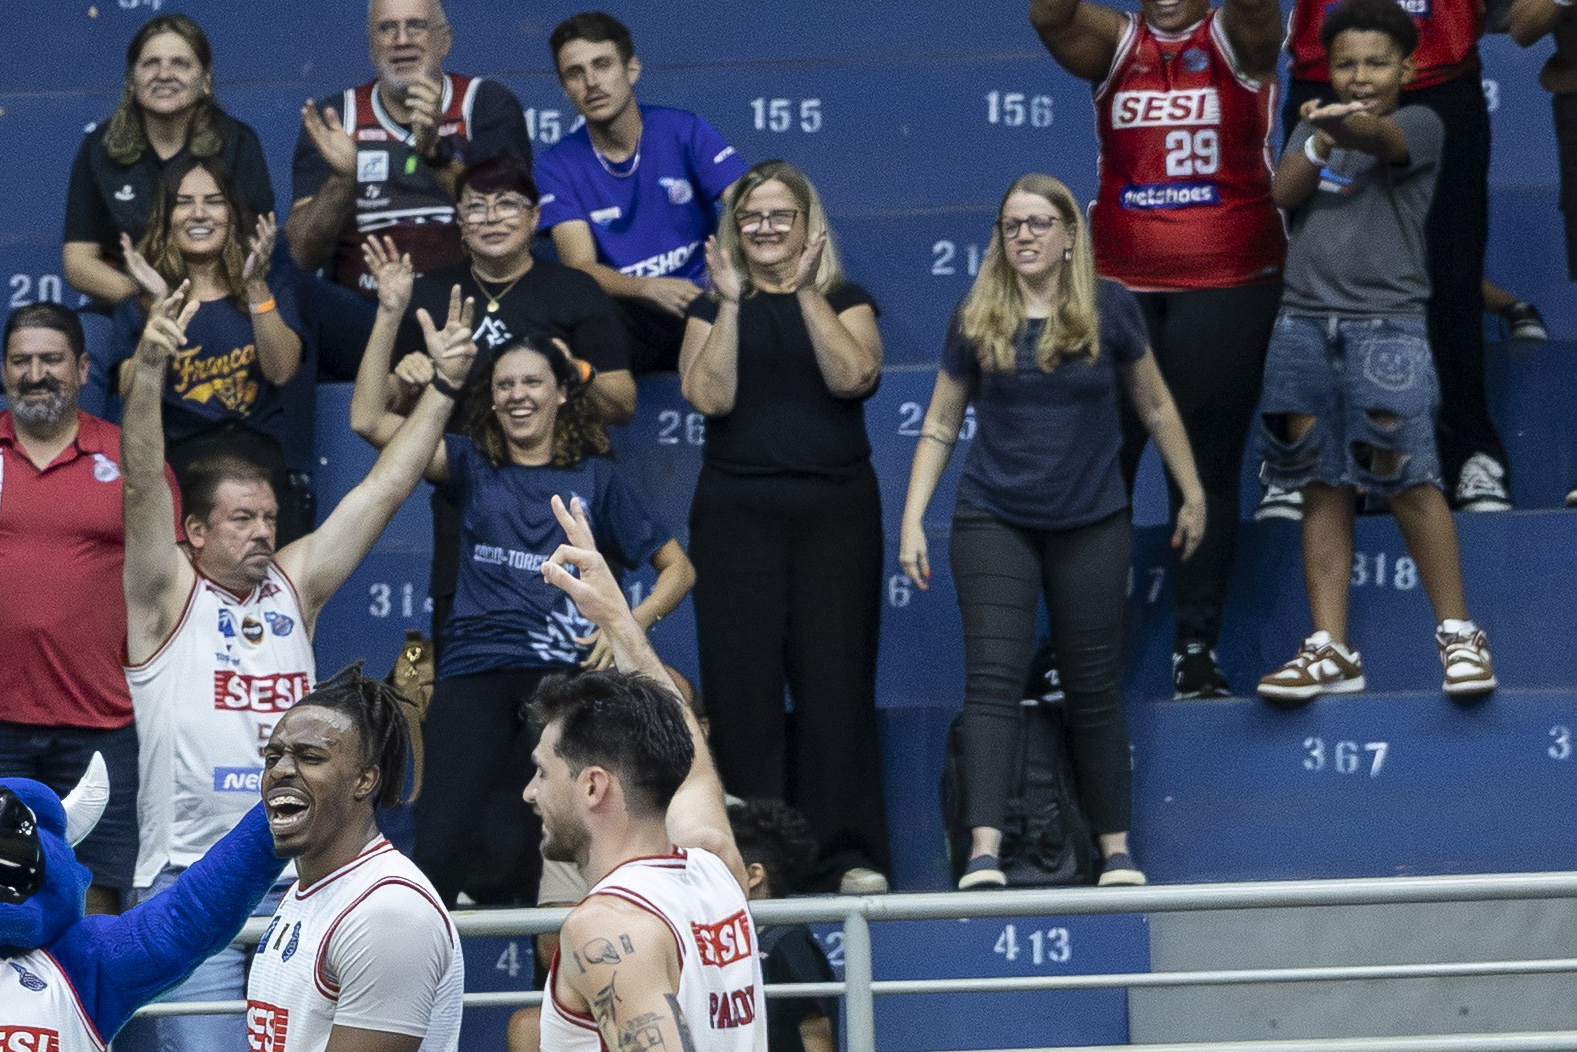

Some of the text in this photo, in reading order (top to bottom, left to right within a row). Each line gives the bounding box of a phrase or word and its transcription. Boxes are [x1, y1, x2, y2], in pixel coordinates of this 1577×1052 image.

[751, 98, 822, 133] 155
[987, 91, 1054, 128] 156
[1119, 94, 1207, 124] SESI
[1165, 129, 1219, 177] 29
[9, 273, 88, 308] 20
[223, 676, 305, 710] SESI
[1302, 736, 1389, 778] 367
[993, 924, 1071, 965] 413
